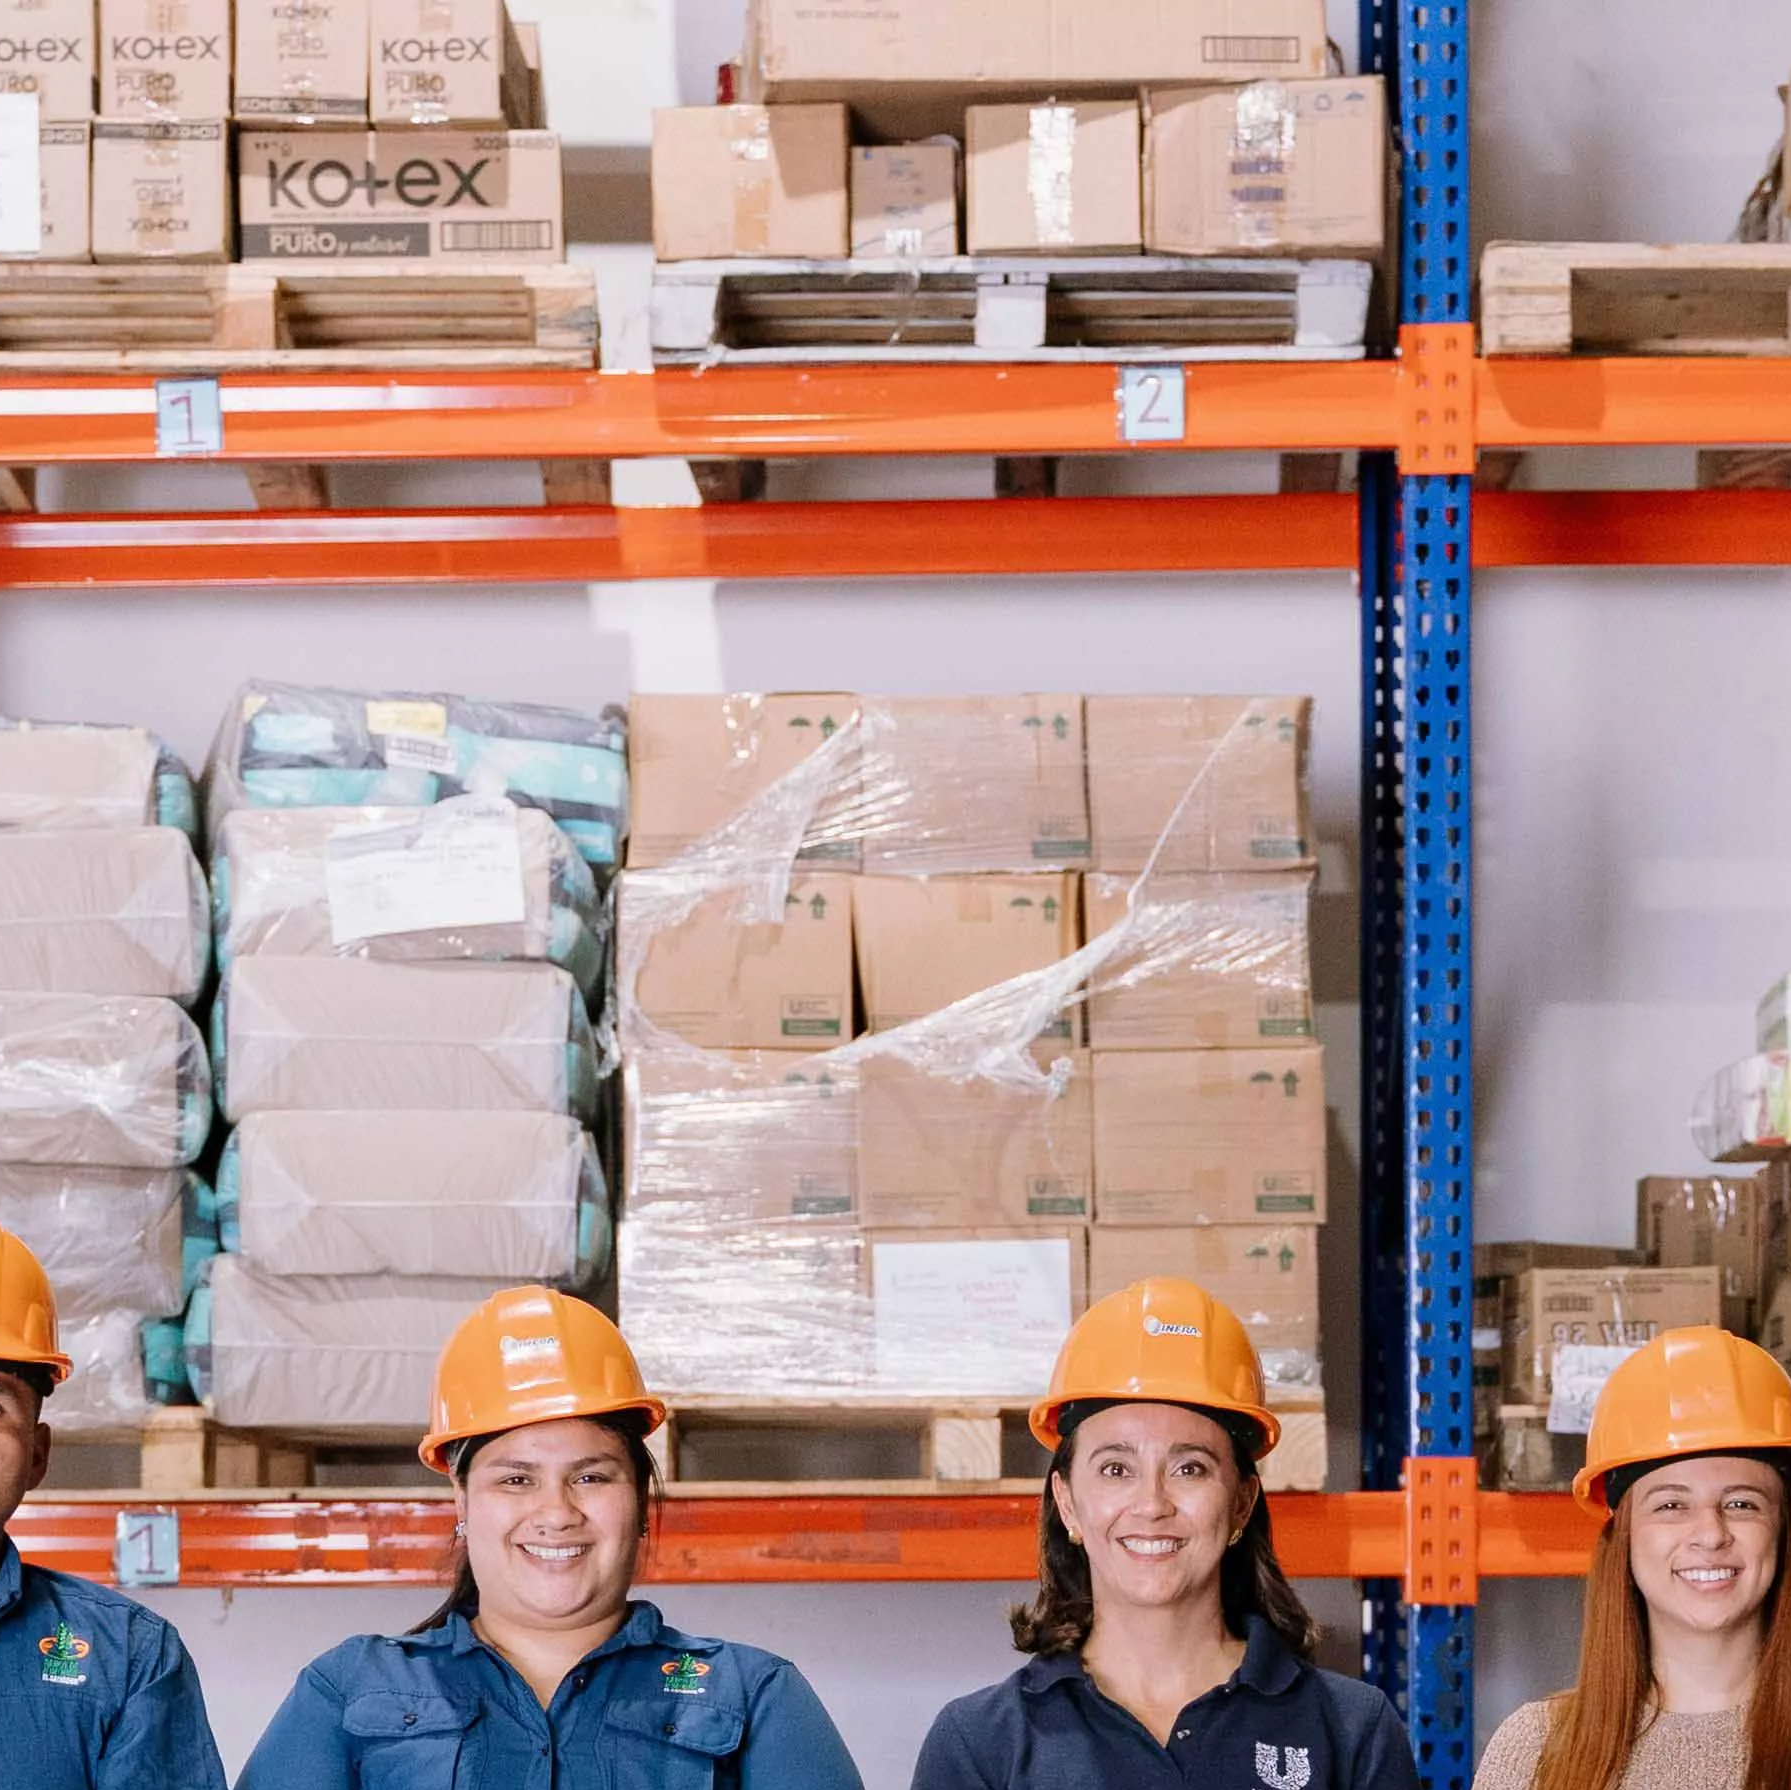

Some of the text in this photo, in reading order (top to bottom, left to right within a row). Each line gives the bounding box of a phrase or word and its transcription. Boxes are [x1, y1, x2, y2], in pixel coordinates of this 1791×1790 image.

[113, 36, 221, 61] Kotex
[381, 38, 491, 63] Kotex
[268, 159, 490, 208] Kotex
[269, 232, 336, 252] PURO
[158, 390, 206, 446] 1
[1135, 374, 1171, 424] 2
[127, 1523, 166, 1576] 1
